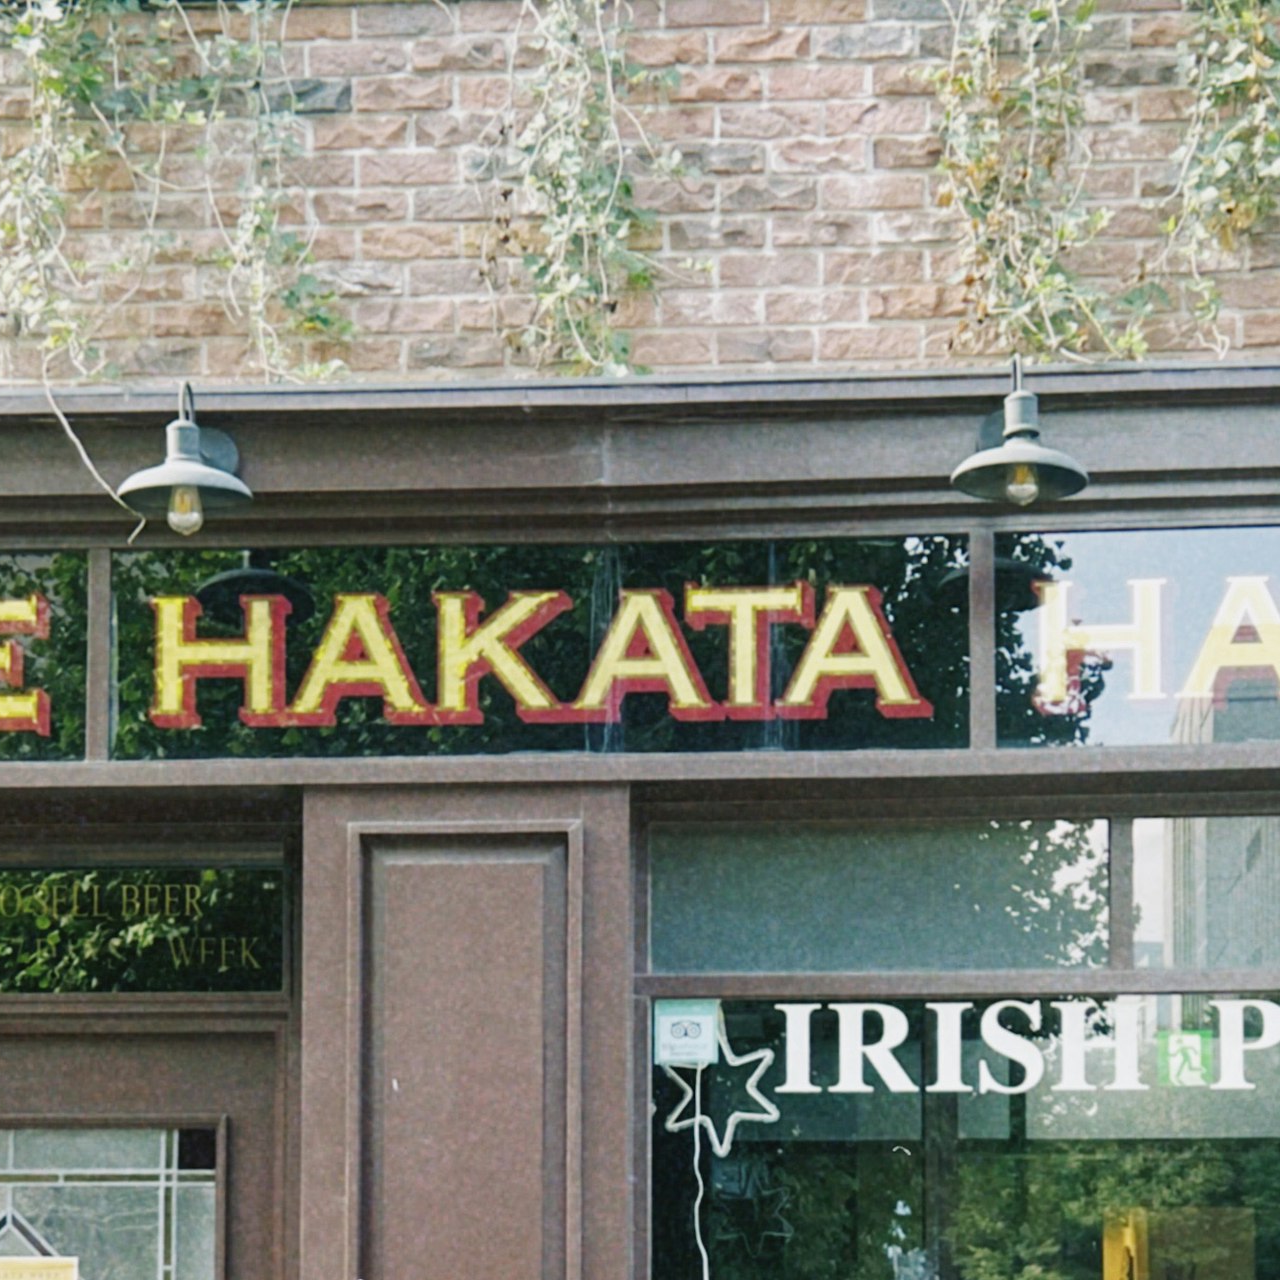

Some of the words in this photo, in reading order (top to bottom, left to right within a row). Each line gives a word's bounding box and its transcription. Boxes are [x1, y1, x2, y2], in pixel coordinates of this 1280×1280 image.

[150, 588, 932, 729] HAKATA
[121, 884, 203, 918] BEER
[774, 997, 1149, 1094] IRISH
